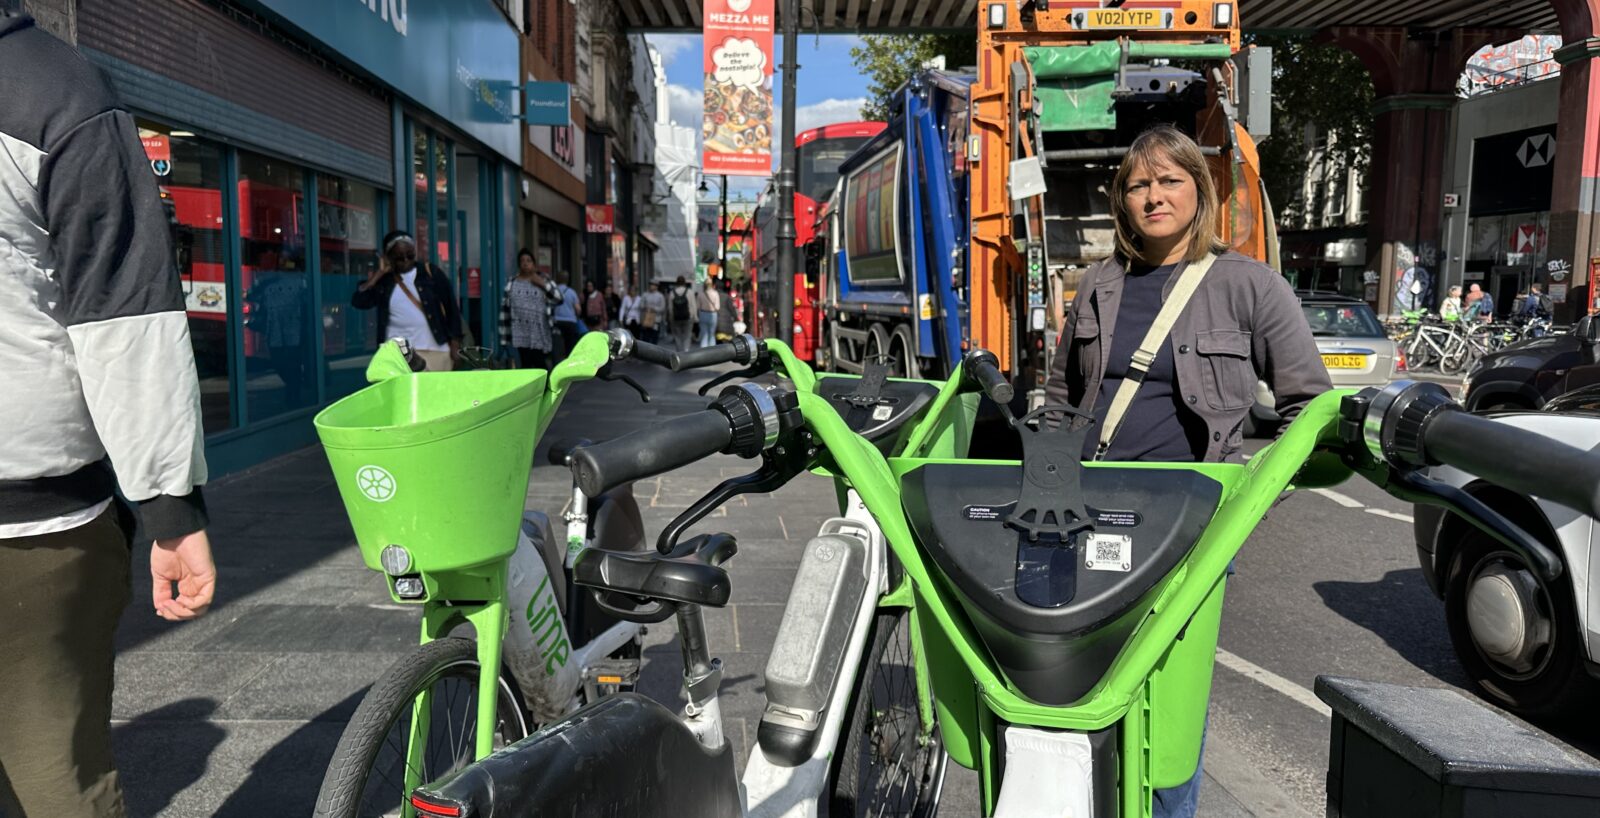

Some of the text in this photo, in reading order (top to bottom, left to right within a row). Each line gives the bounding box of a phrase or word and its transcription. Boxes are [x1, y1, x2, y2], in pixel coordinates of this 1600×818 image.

[709, 13, 770, 25] MEZZA ME
[1096, 12, 1153, 25] VO21 YTP
[587, 224, 612, 233] LEON
[1324, 356, 1340, 366] O10
[526, 575, 569, 676] Lime
